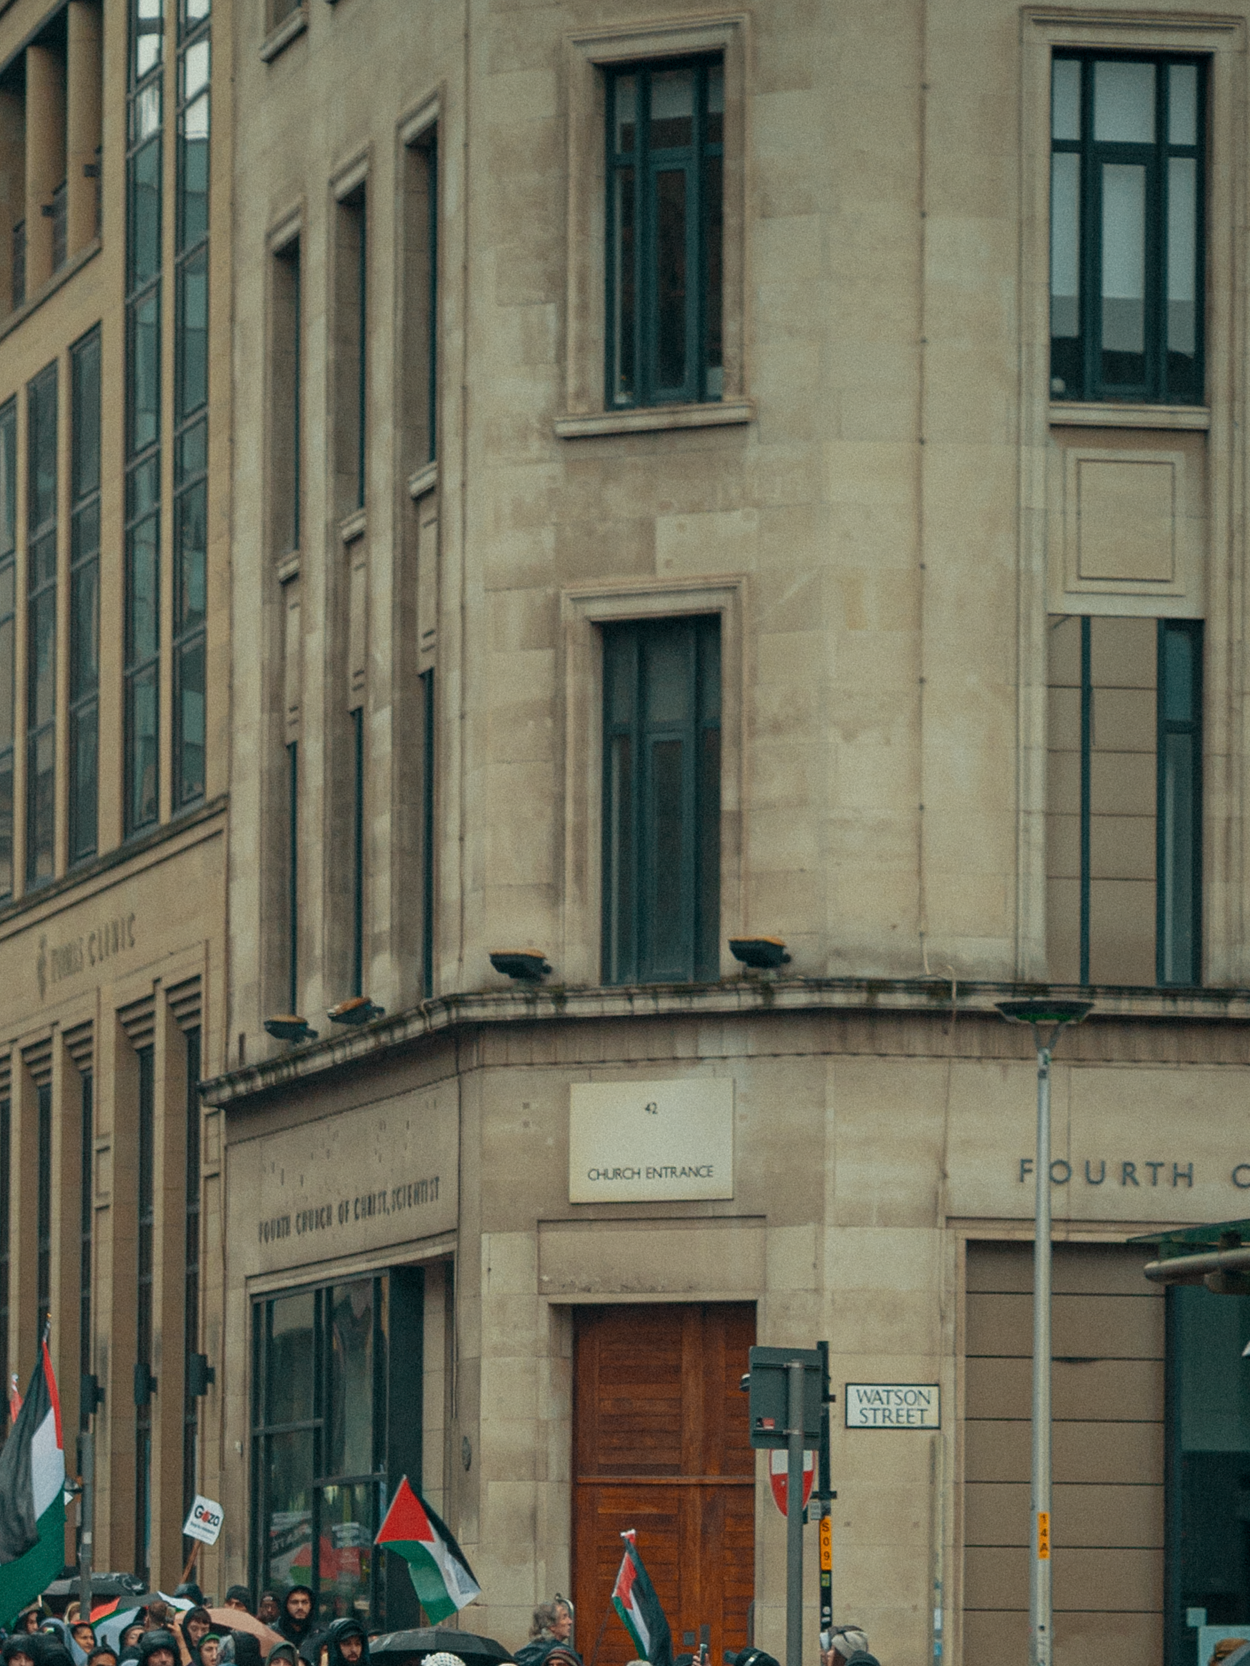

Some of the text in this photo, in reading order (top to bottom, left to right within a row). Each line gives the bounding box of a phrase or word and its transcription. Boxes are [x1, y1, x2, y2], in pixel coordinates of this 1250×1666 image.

[645, 1102, 658, 1115] 42
[587, 1165, 714, 1182] CHURCH ENTRANCE
[1019, 1158, 1194, 1188] FOURTH
[258, 1214, 291, 1244] FOURTH
[296, 1203, 333, 1236] CHURCH
[338, 1200, 350, 1226] OF
[856, 1389, 932, 1406] WATSON
[859, 1407, 929, 1425] STREET
[194, 1505, 220, 1527] Gza
